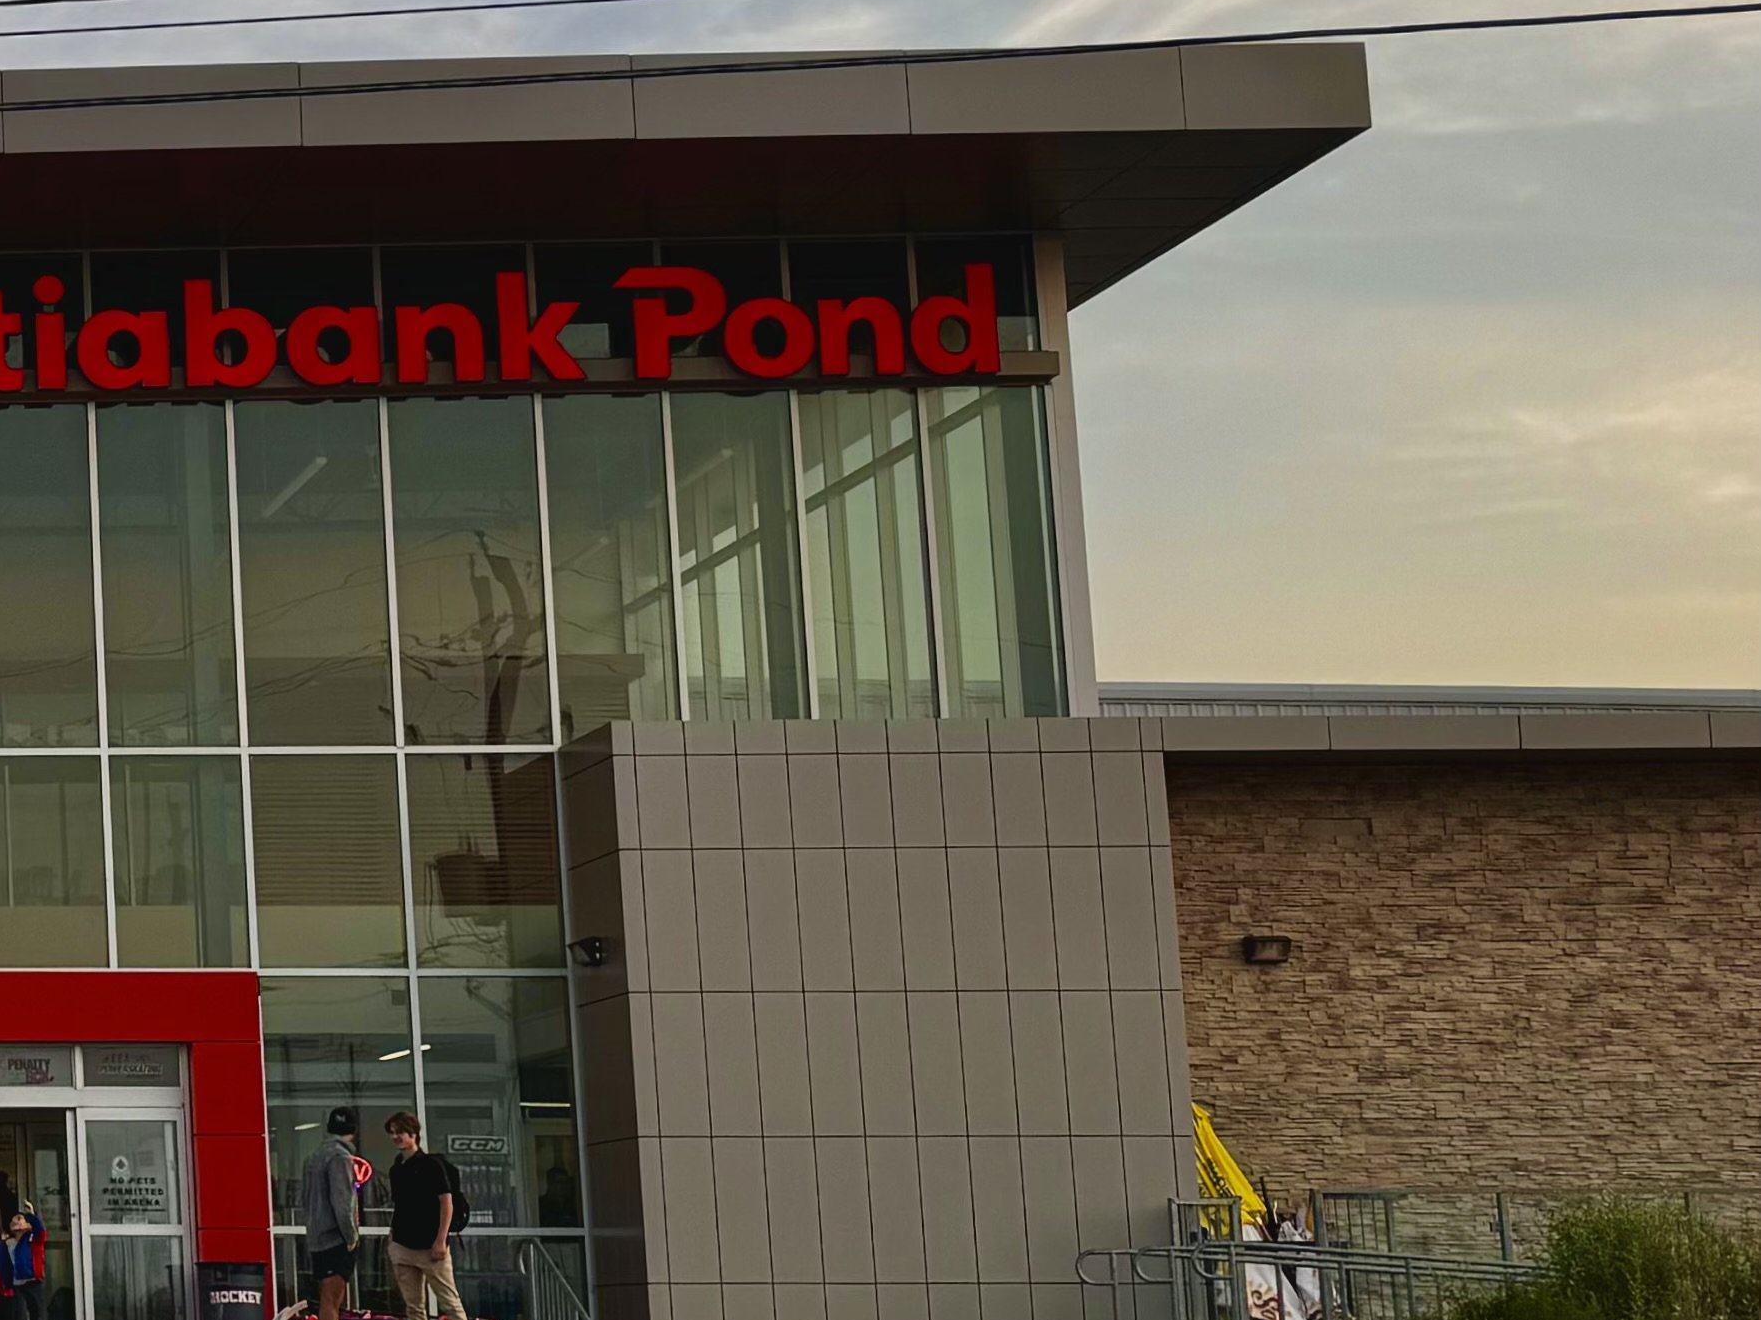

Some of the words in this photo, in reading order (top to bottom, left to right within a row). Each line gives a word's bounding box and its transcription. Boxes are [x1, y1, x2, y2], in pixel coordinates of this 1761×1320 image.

[613, 266, 998, 379] Pond
[451, 1137, 505, 1152] CCM
[128, 1177, 157, 1185] PETS
[108, 1198, 120, 1206] IN
[124, 1198, 161, 1206] ARENA
[209, 1290, 263, 1305] HOCKEY
